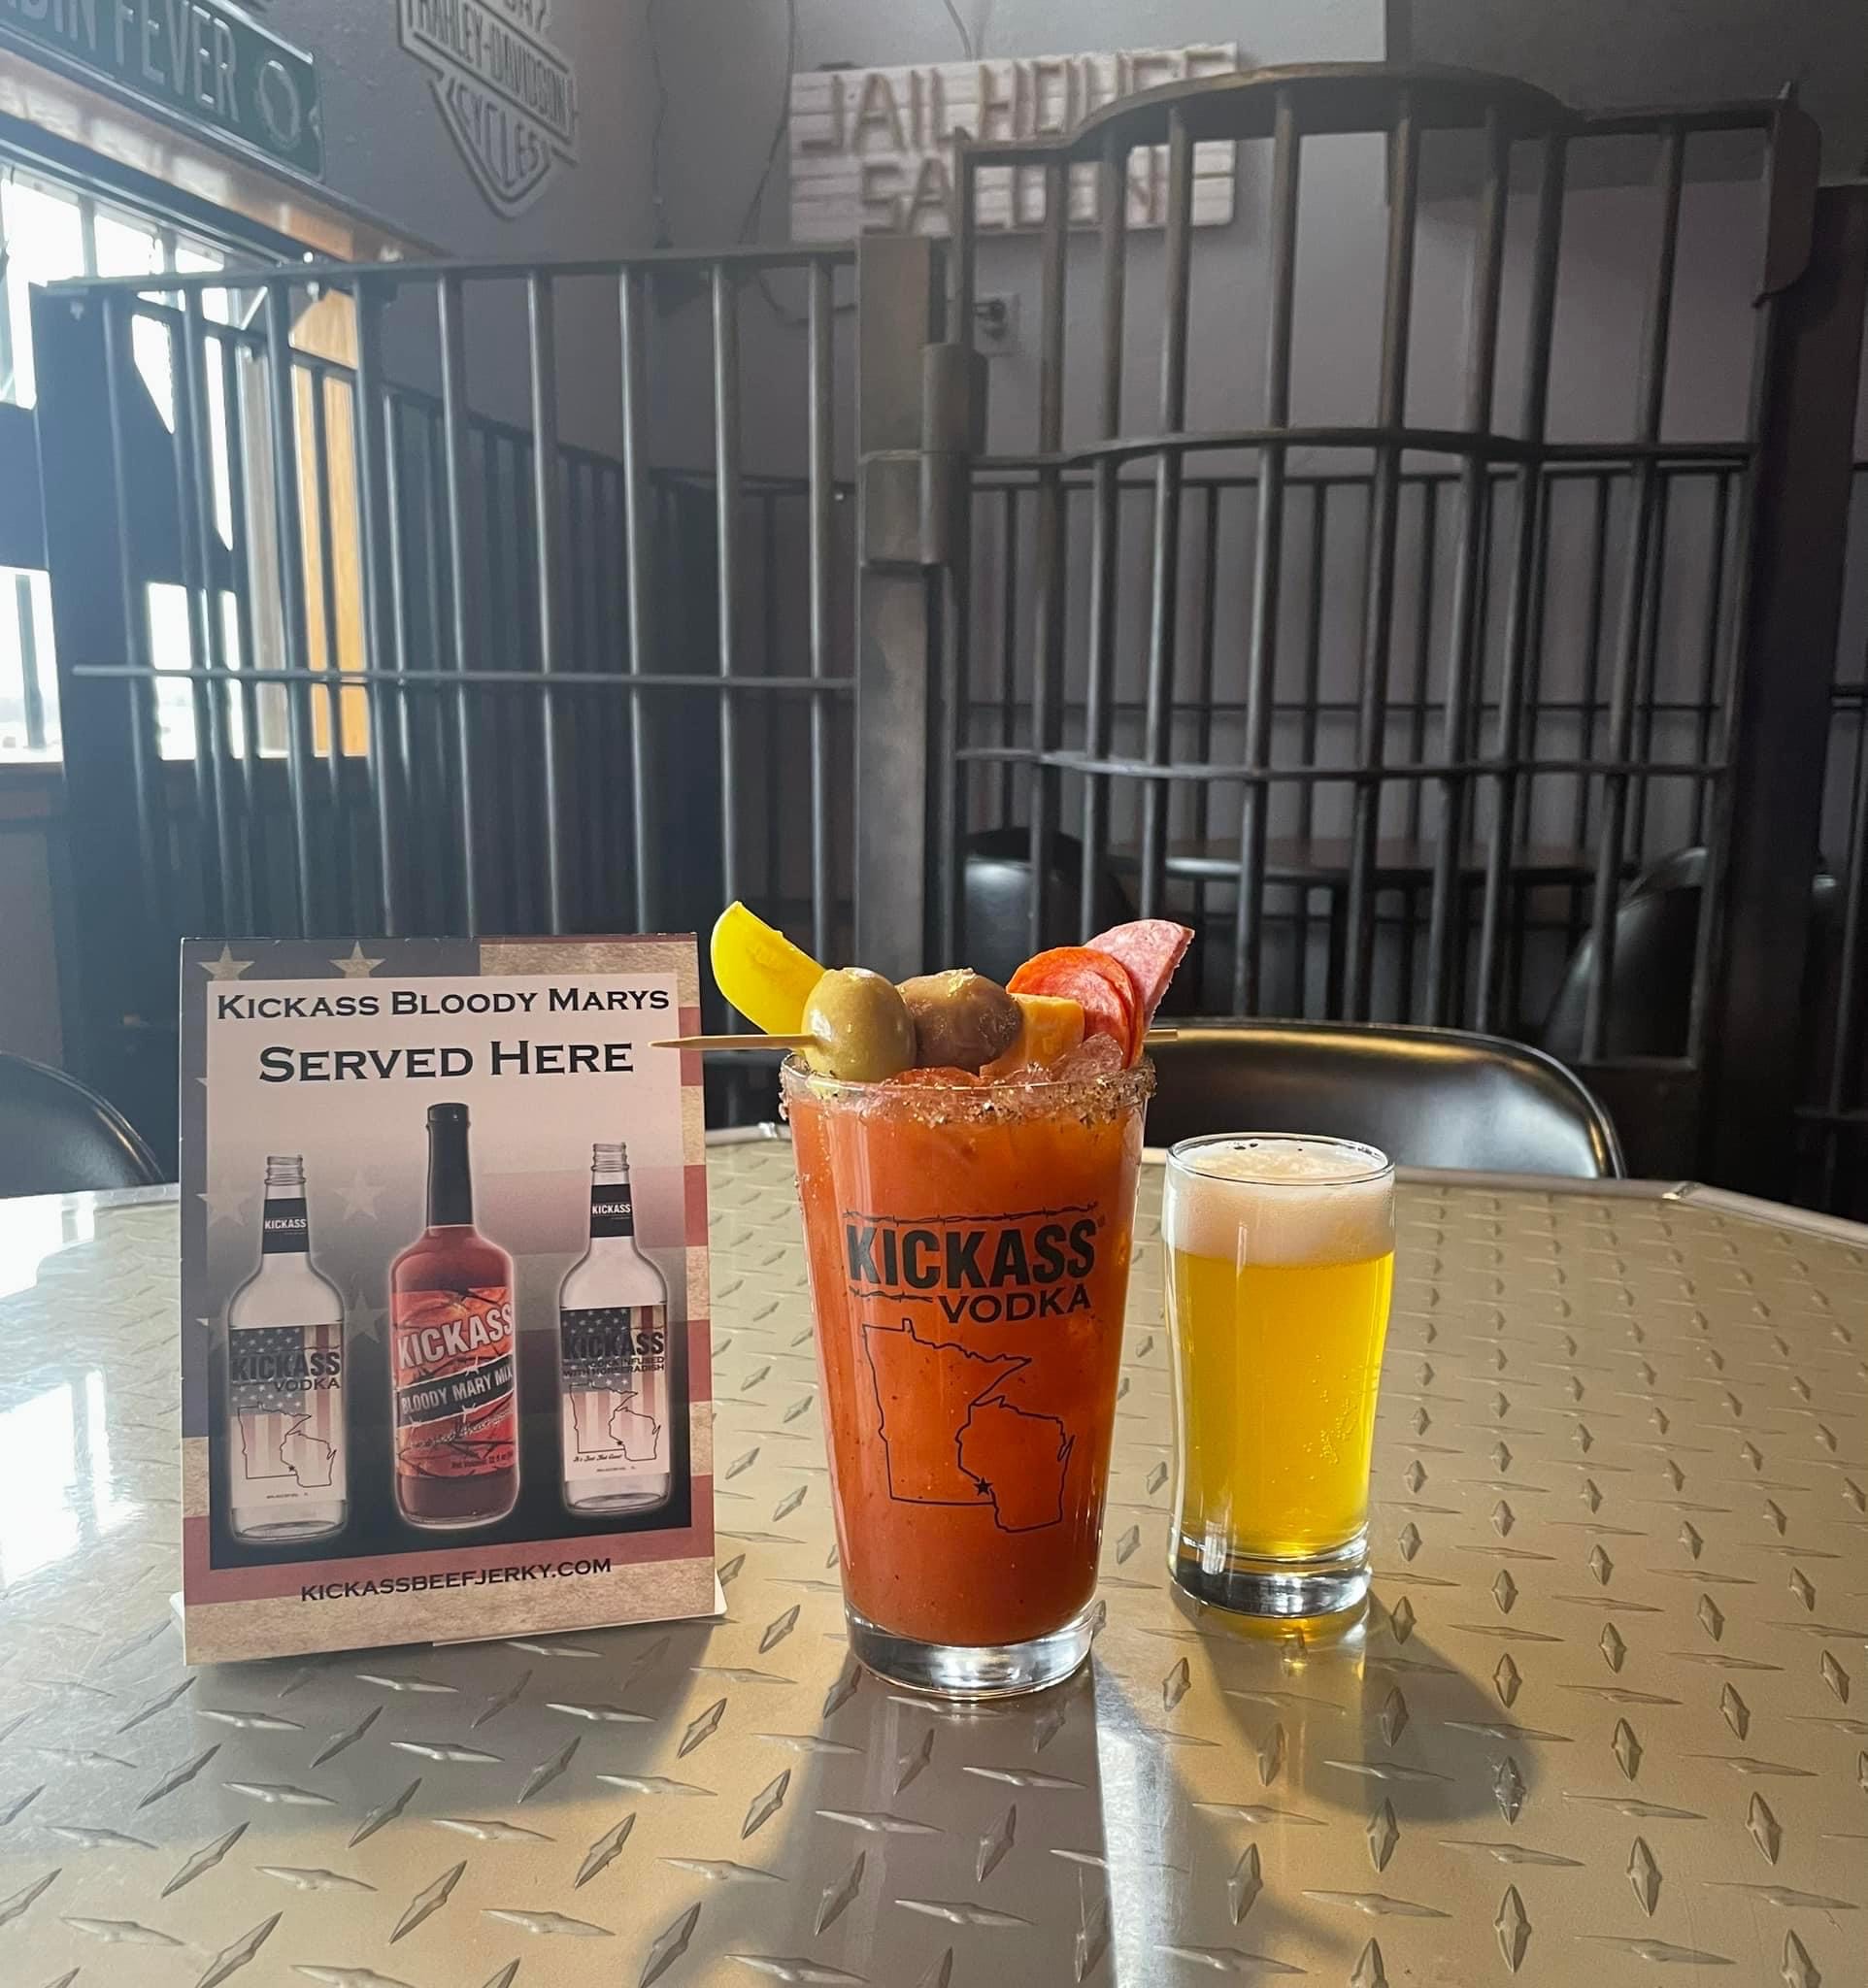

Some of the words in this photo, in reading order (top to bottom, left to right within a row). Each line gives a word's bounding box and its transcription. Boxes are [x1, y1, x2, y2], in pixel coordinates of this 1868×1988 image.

[114, 0, 241, 122] FEVER
[801, 68, 961, 153] JAIL
[978, 50, 1226, 142] HOU
[217, 993, 381, 1020] KICKASS
[390, 989, 539, 1016] BLOODY
[548, 986, 671, 1012] MARYS
[258, 1045, 474, 1083] SERVED
[489, 1040, 635, 1077] HERE
[264, 1218, 307, 1230] KICKASS
[592, 1204, 631, 1215] KICKASS
[845, 1217, 1097, 1290] KICKASS
[938, 1283, 1092, 1324] VODKA
[396, 1303, 514, 1370] KICKASS
[562, 1331, 665, 1360] KICKASS
[231, 1351, 341, 1381] KICKASS
[274, 1377, 341, 1392] VODKA
[401, 1387, 449, 1415] BLOODY
[451, 1374, 493, 1403] MARY
[494, 1365, 513, 1387] MIX
[300, 1557, 612, 1602] KICKASSBEEFJERKY.COM
